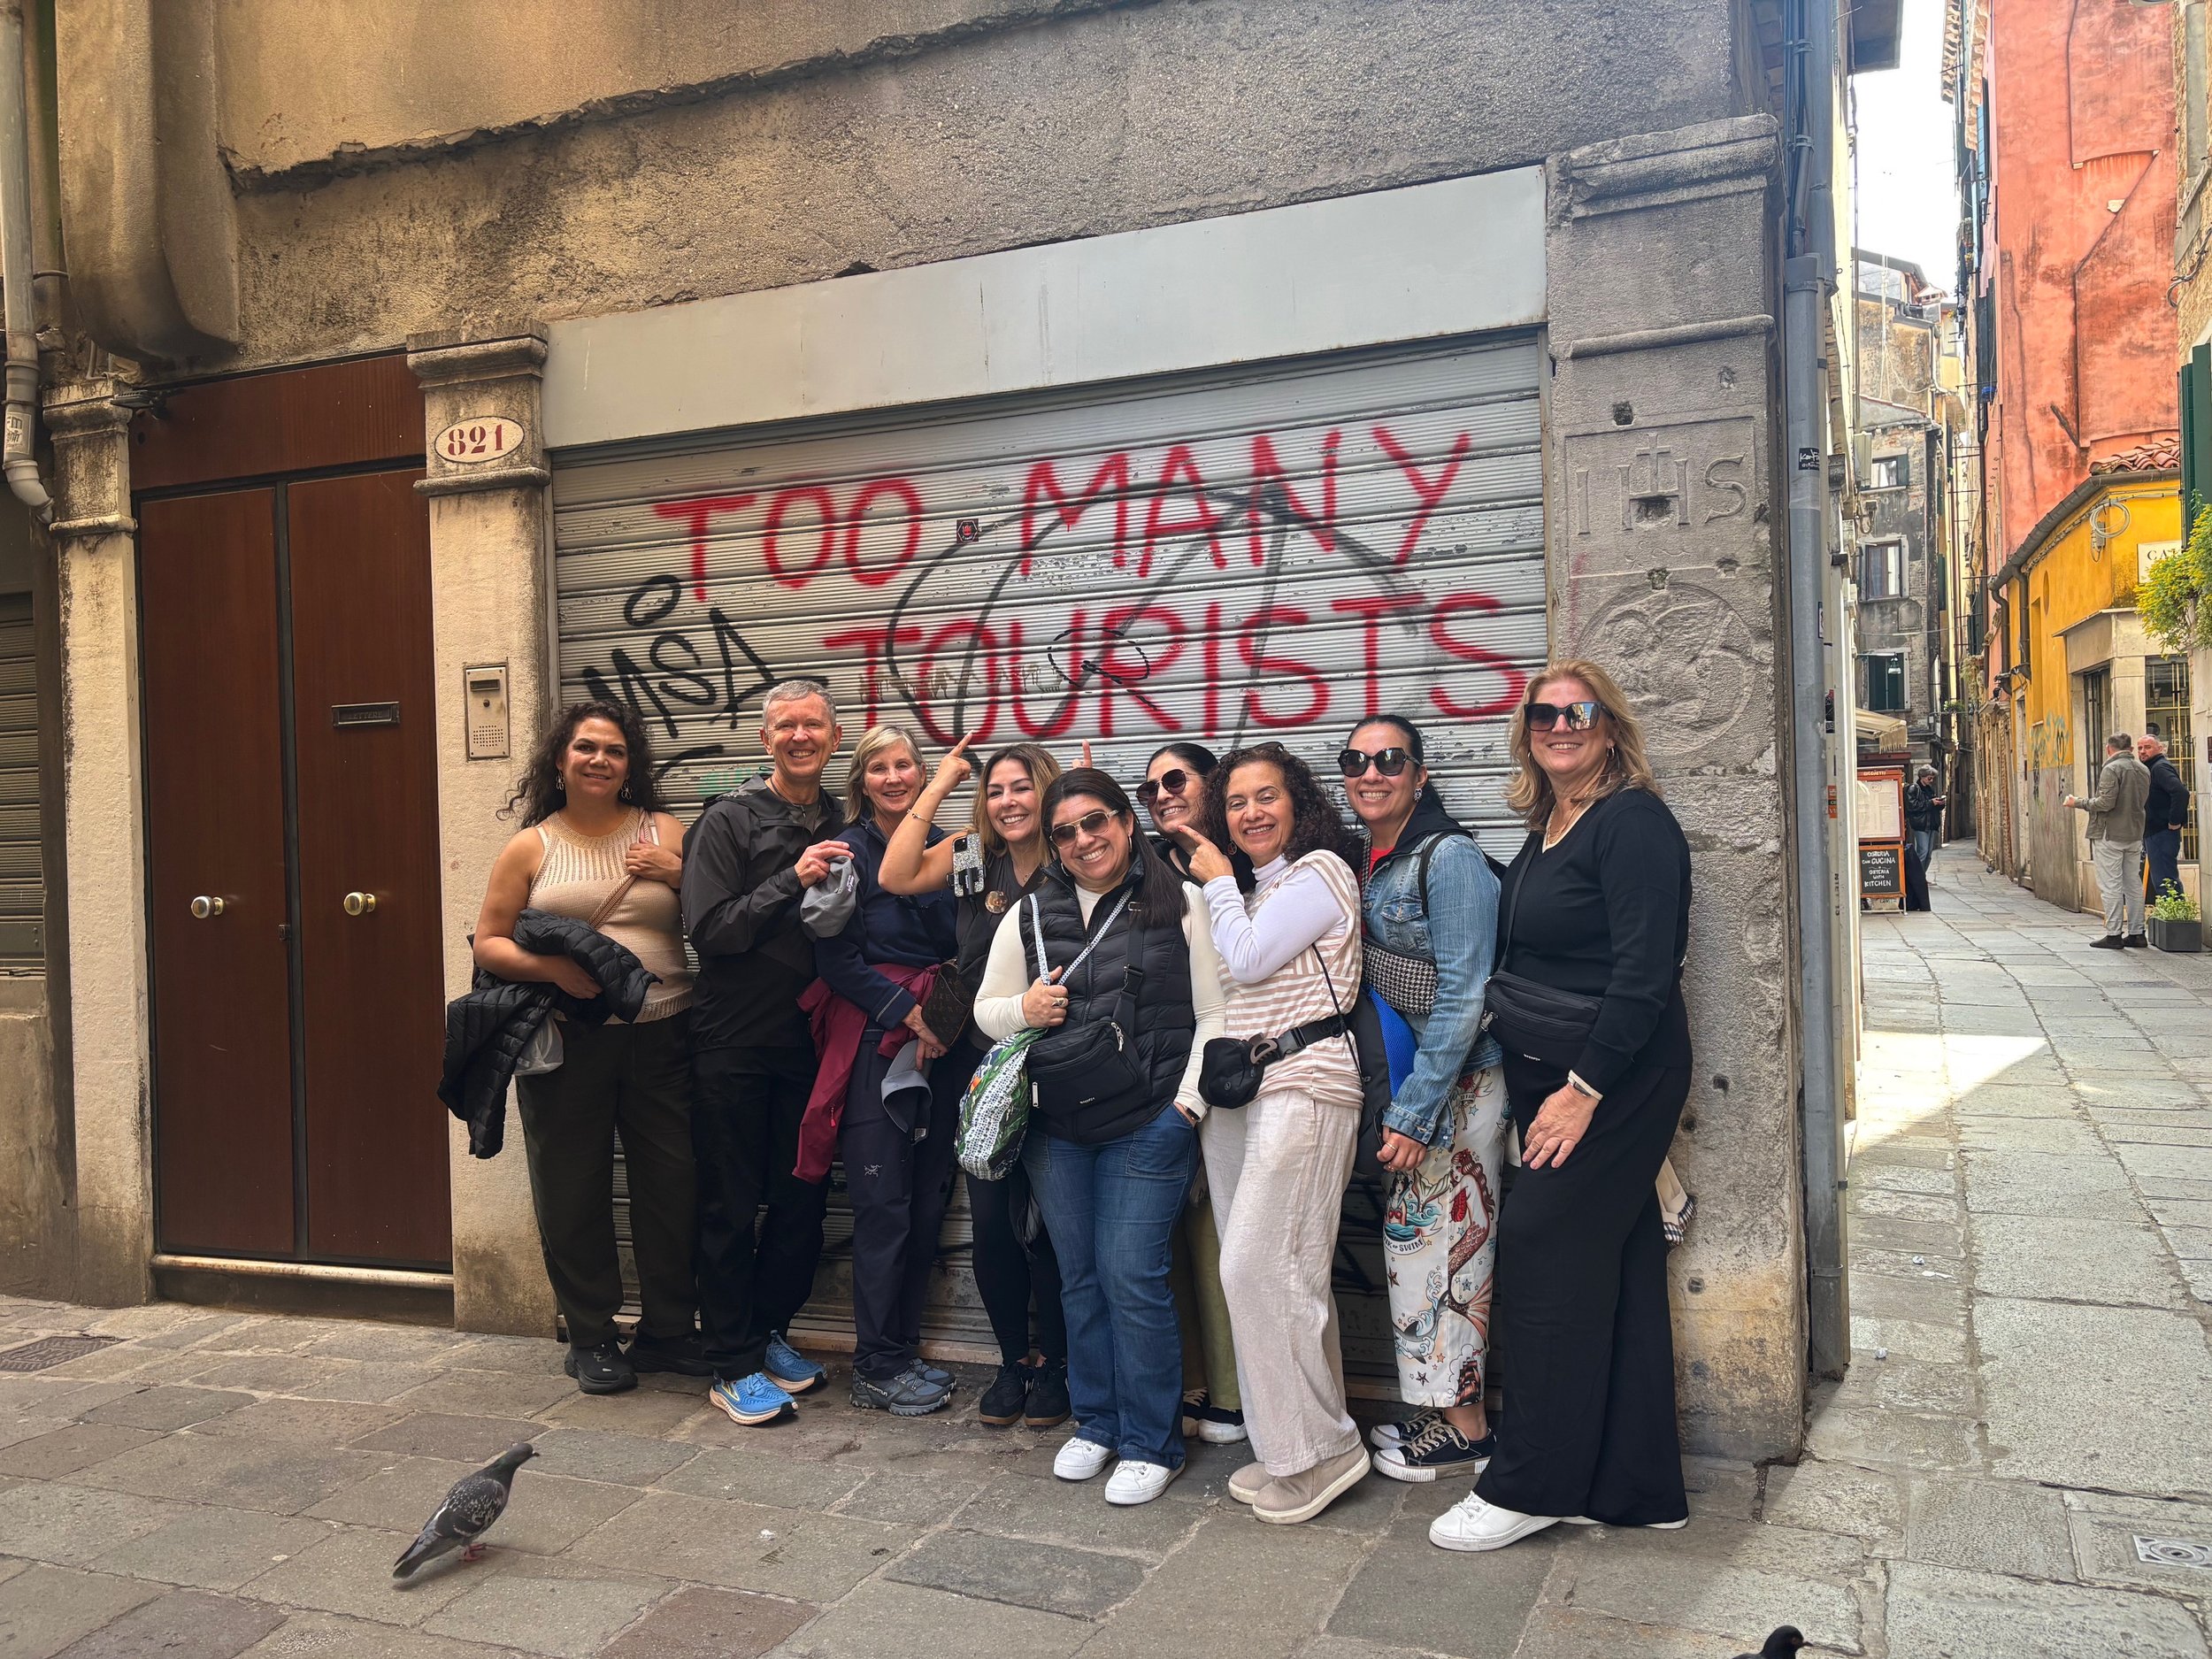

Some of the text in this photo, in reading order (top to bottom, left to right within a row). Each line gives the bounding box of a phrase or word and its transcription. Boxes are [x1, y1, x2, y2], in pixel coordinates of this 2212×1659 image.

[447, 424, 503, 456] 821
[1575, 432, 1742, 535] IHS
[651, 424, 1472, 604] TOO MANY
[821, 590, 1529, 746] TOURISTS
[1399, 1239, 1423, 1252] SWIM
